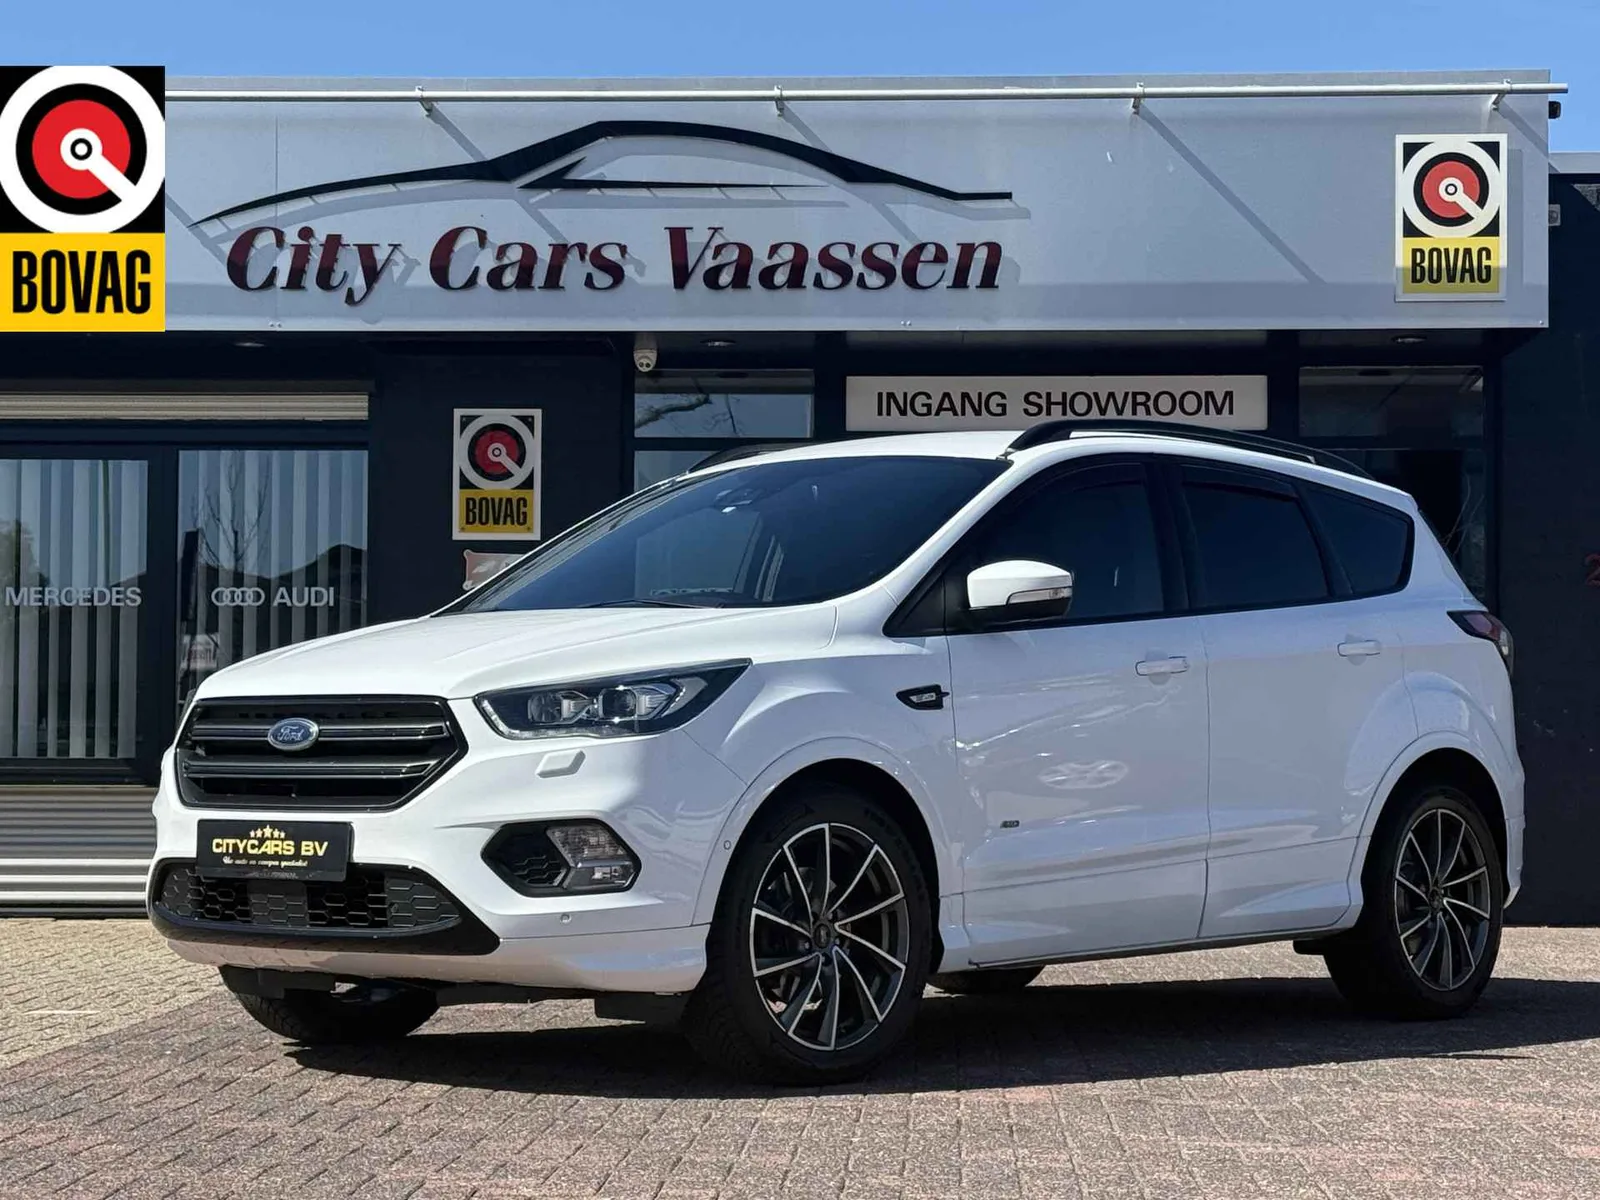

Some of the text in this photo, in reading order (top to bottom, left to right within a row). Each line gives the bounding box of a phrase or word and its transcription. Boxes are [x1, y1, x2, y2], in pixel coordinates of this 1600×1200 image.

[226, 226, 1003, 306] City Cars Vaassen
[1411, 247, 1492, 284] BOVAG
[876, 390, 1234, 417] INGANG SHOWROOM
[465, 497, 528, 526] BOVAG
[5, 587, 142, 606] MERCEDES
[272, 587, 335, 606] AUDI
[277, 726, 304, 741] Ford
[212, 839, 328, 856] CITYCARS BV
